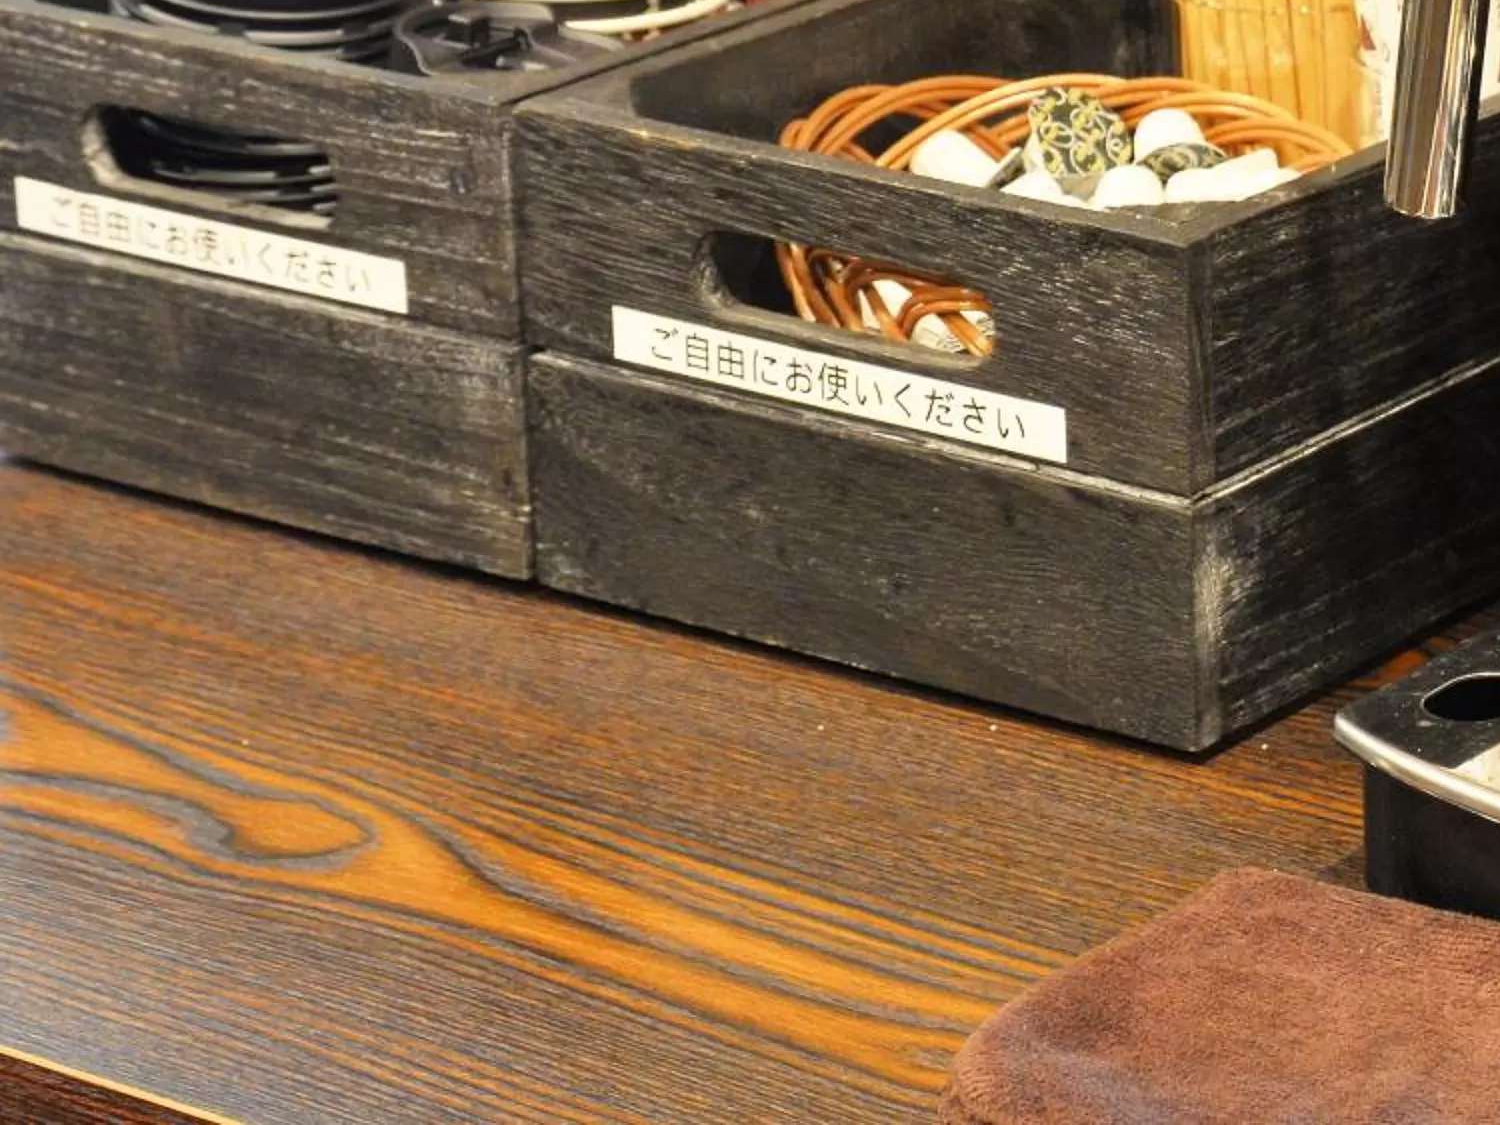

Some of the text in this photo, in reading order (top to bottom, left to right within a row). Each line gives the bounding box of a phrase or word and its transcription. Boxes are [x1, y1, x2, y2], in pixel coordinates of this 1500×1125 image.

[50, 195, 372, 294] ご自由にお使いください
[649, 325, 1027, 443] ご自由にお使いください
